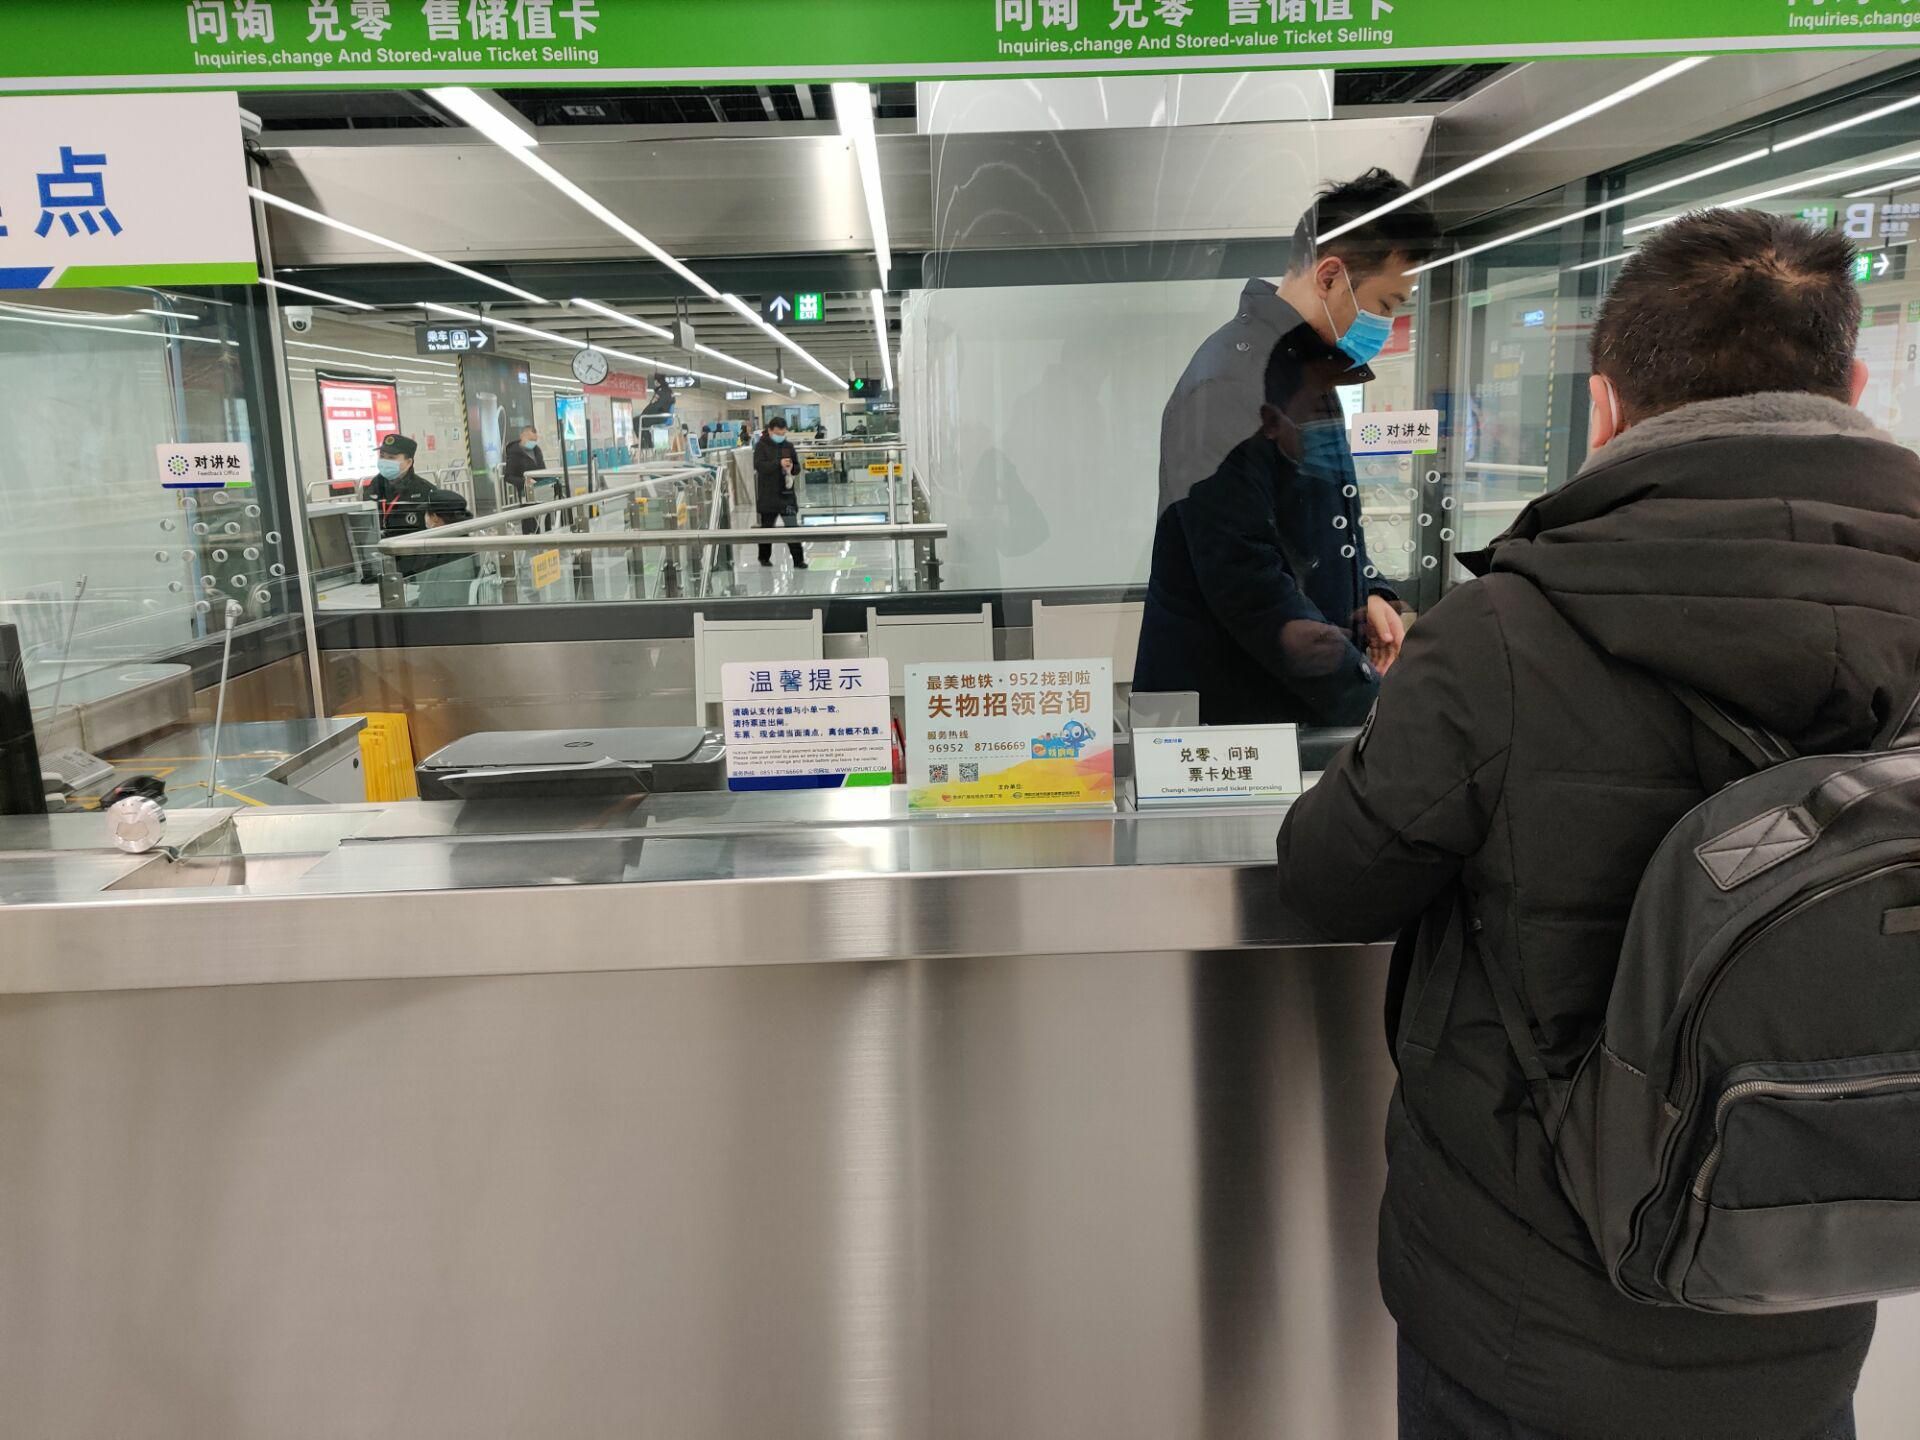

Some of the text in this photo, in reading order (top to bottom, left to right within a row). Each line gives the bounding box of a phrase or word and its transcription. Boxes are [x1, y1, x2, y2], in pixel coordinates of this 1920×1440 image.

[186, 0, 600, 43] 问询 兑零 售储值卡
[995, 0, 1079, 32] 问询
[998, 27, 1393, 56] Inquiries,change And Stored-value Ticket Selling
[194, 46, 599, 69] Inquiries,change And Stored-value Ticket Selling
[0, 146, 123, 238] 点
[800, 311, 818, 320] EXIT
[427, 329, 448, 343] 乘车
[1386, 422, 1431, 438] 对讲处
[194, 454, 241, 469] 对讲处
[749, 668, 862, 693] 温馨提示
[928, 689, 1092, 719] 失物招领咨询
[927, 729, 969, 740] 服务热线
[928, 741, 1026, 753] 96952 87166669
[1180, 746, 1259, 763] 兑零、问询
[1188, 765, 1253, 782] 票卡处理
[1248, 783, 1283, 792] processing
